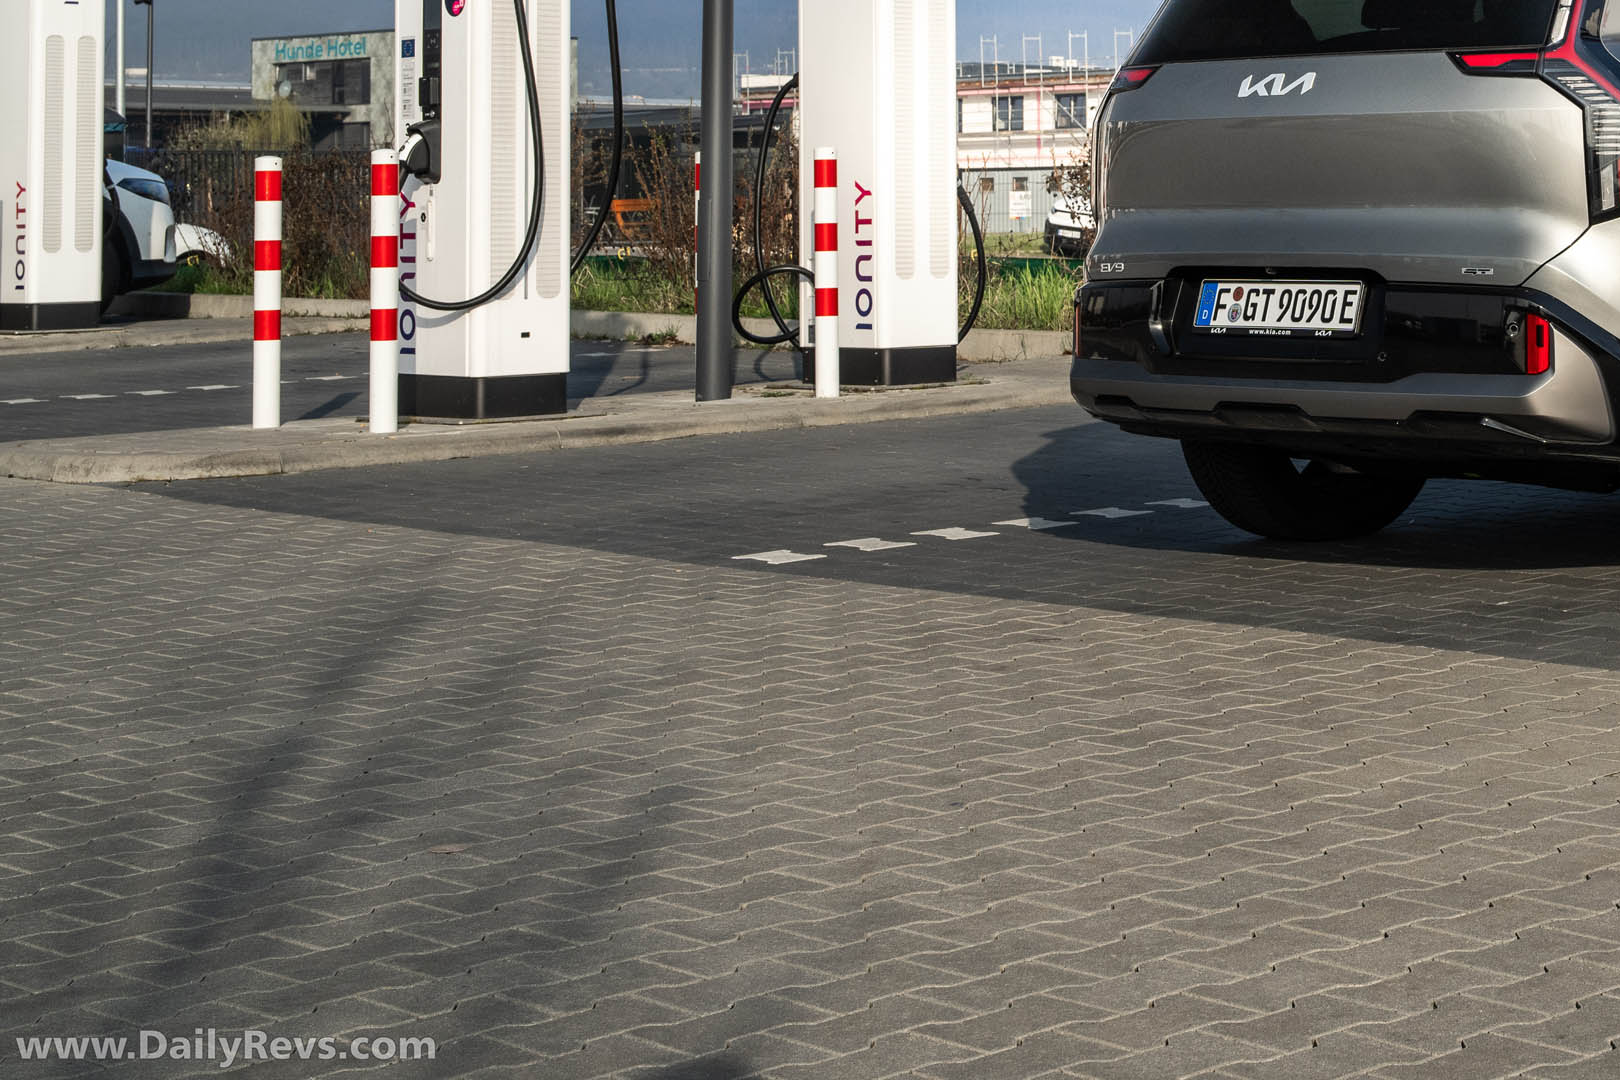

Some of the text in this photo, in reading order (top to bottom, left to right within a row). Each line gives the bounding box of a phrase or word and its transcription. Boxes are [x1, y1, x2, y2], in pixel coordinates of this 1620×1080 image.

[275, 37, 366, 60] Hunde Hotel
[1237, 72, 1316, 97] KIA
[15, 180, 27, 291] IONITY
[855, 180, 873, 330] IONITY
[1100, 262, 1124, 273] EV9
[1212, 288, 1231, 322] F
[1242, 288, 1276, 322] GT
